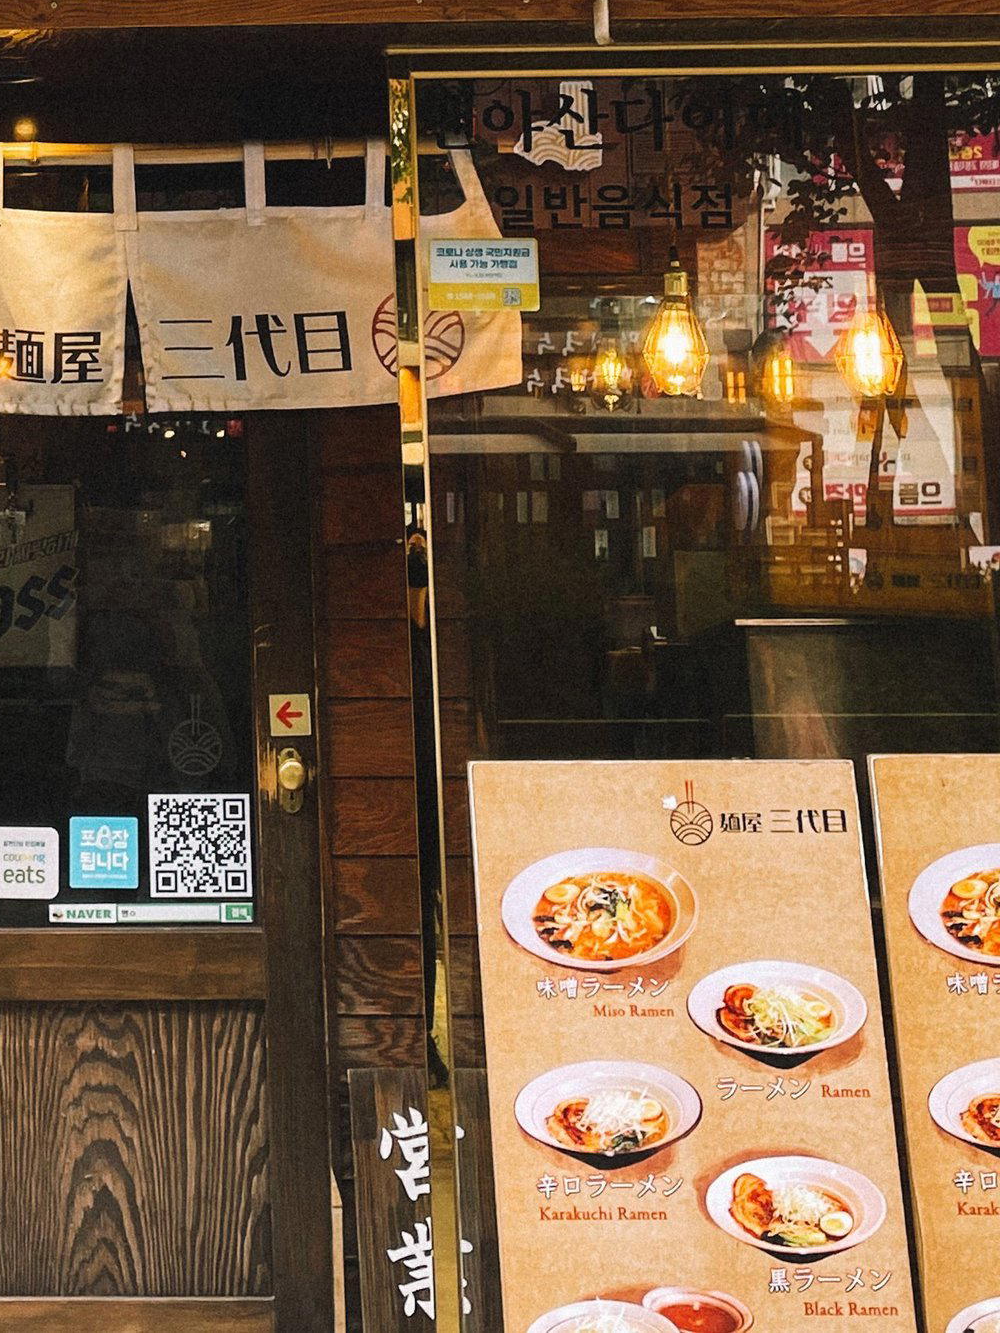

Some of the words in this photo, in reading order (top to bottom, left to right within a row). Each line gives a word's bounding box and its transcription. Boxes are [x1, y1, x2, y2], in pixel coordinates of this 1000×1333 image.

[494, 183, 734, 229] 일반음식점
[159, 310, 353, 383] 三代目
[80, 850, 130, 872] 됩니다
[3, 865, 46, 884] eats
[66, 908, 112, 919] NAVER
[593, 1003, 627, 1018] Miso
[629, 1003, 675, 1018] Ramen
[716, 1076, 813, 1102] ラーメン
[821, 1083, 872, 1099] Ramen
[536, 1173, 685, 1200] 辛口ラーメン
[539, 1206, 614, 1223] Karakuchi
[616, 1206, 668, 1222] Ramen
[767, 1267, 893, 1294] 黒ラーメン
[804, 1301, 844, 1318] Black
[847, 1301, 899, 1318] Ramen
